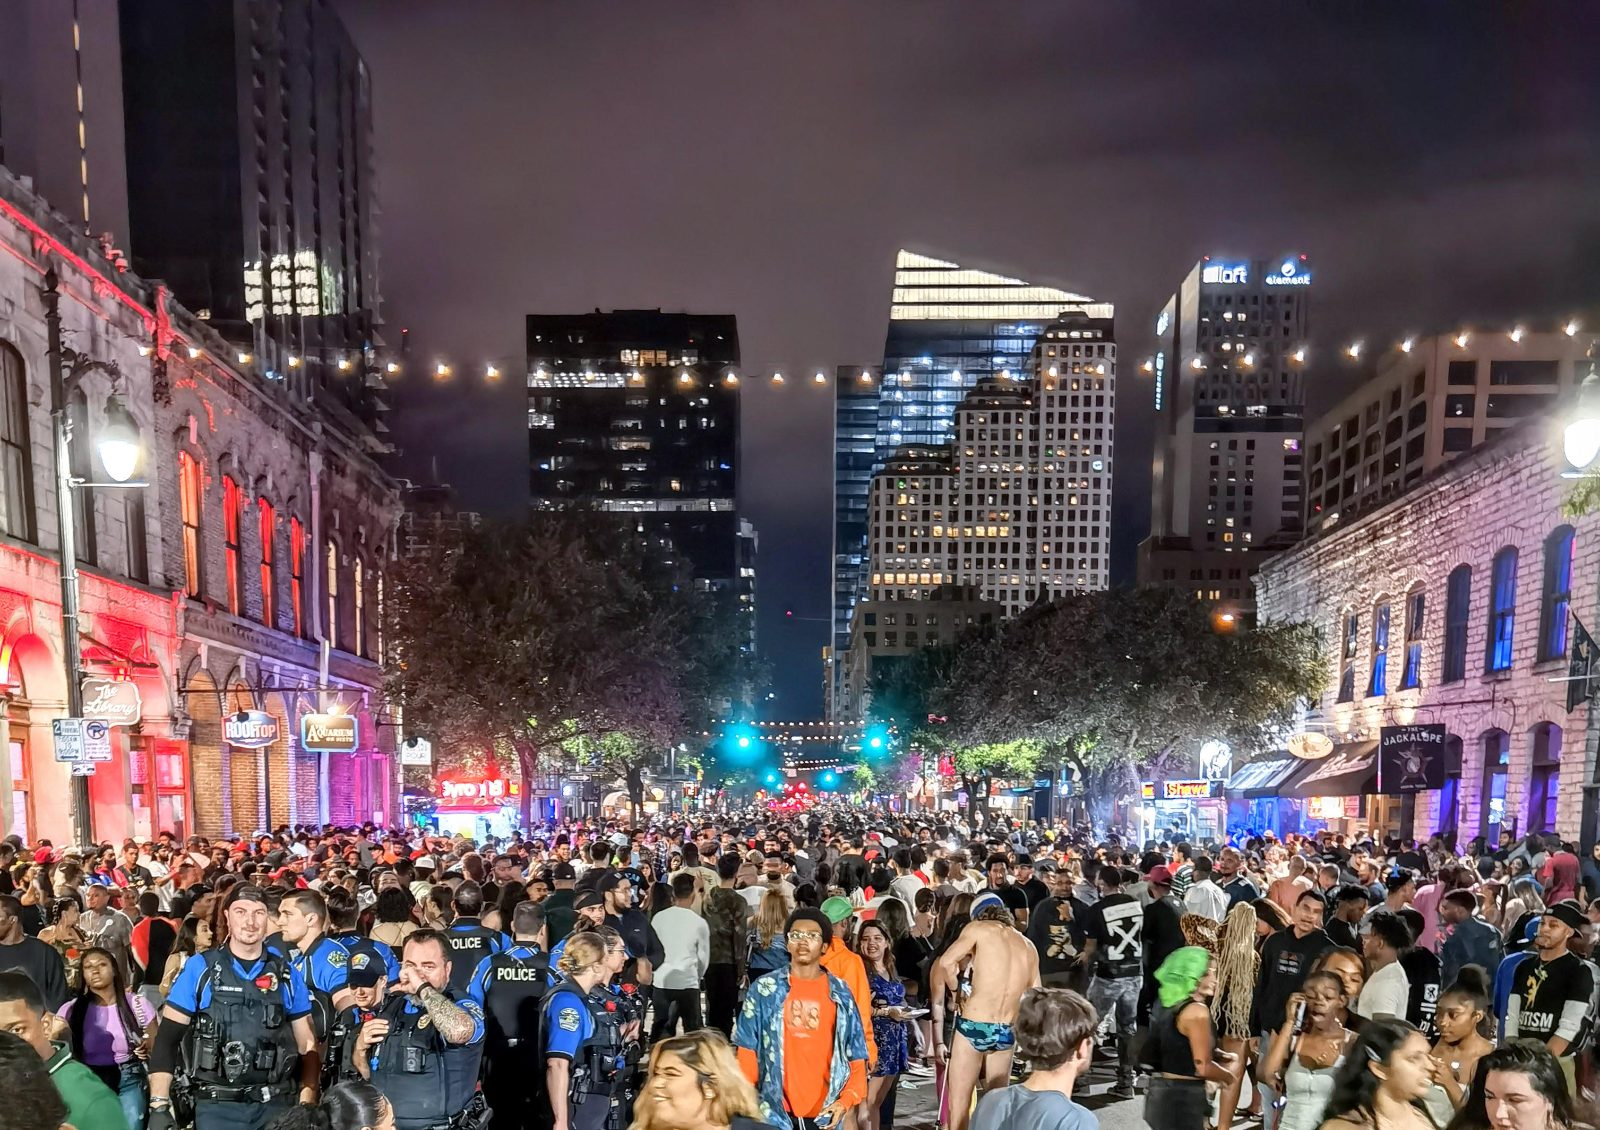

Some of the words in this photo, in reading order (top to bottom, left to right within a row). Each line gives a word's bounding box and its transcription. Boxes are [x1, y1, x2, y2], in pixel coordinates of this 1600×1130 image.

[1266, 275, 1310, 284] element
[95, 684, 118, 699] The
[83, 698, 136, 715] Library
[54, 722, 61, 734] 2
[225, 720, 276, 738] ROOFTOP
[1383, 732, 1442, 746] JACKALOPE
[449, 937, 482, 949] OLICE
[497, 967, 536, 981] POLICE
